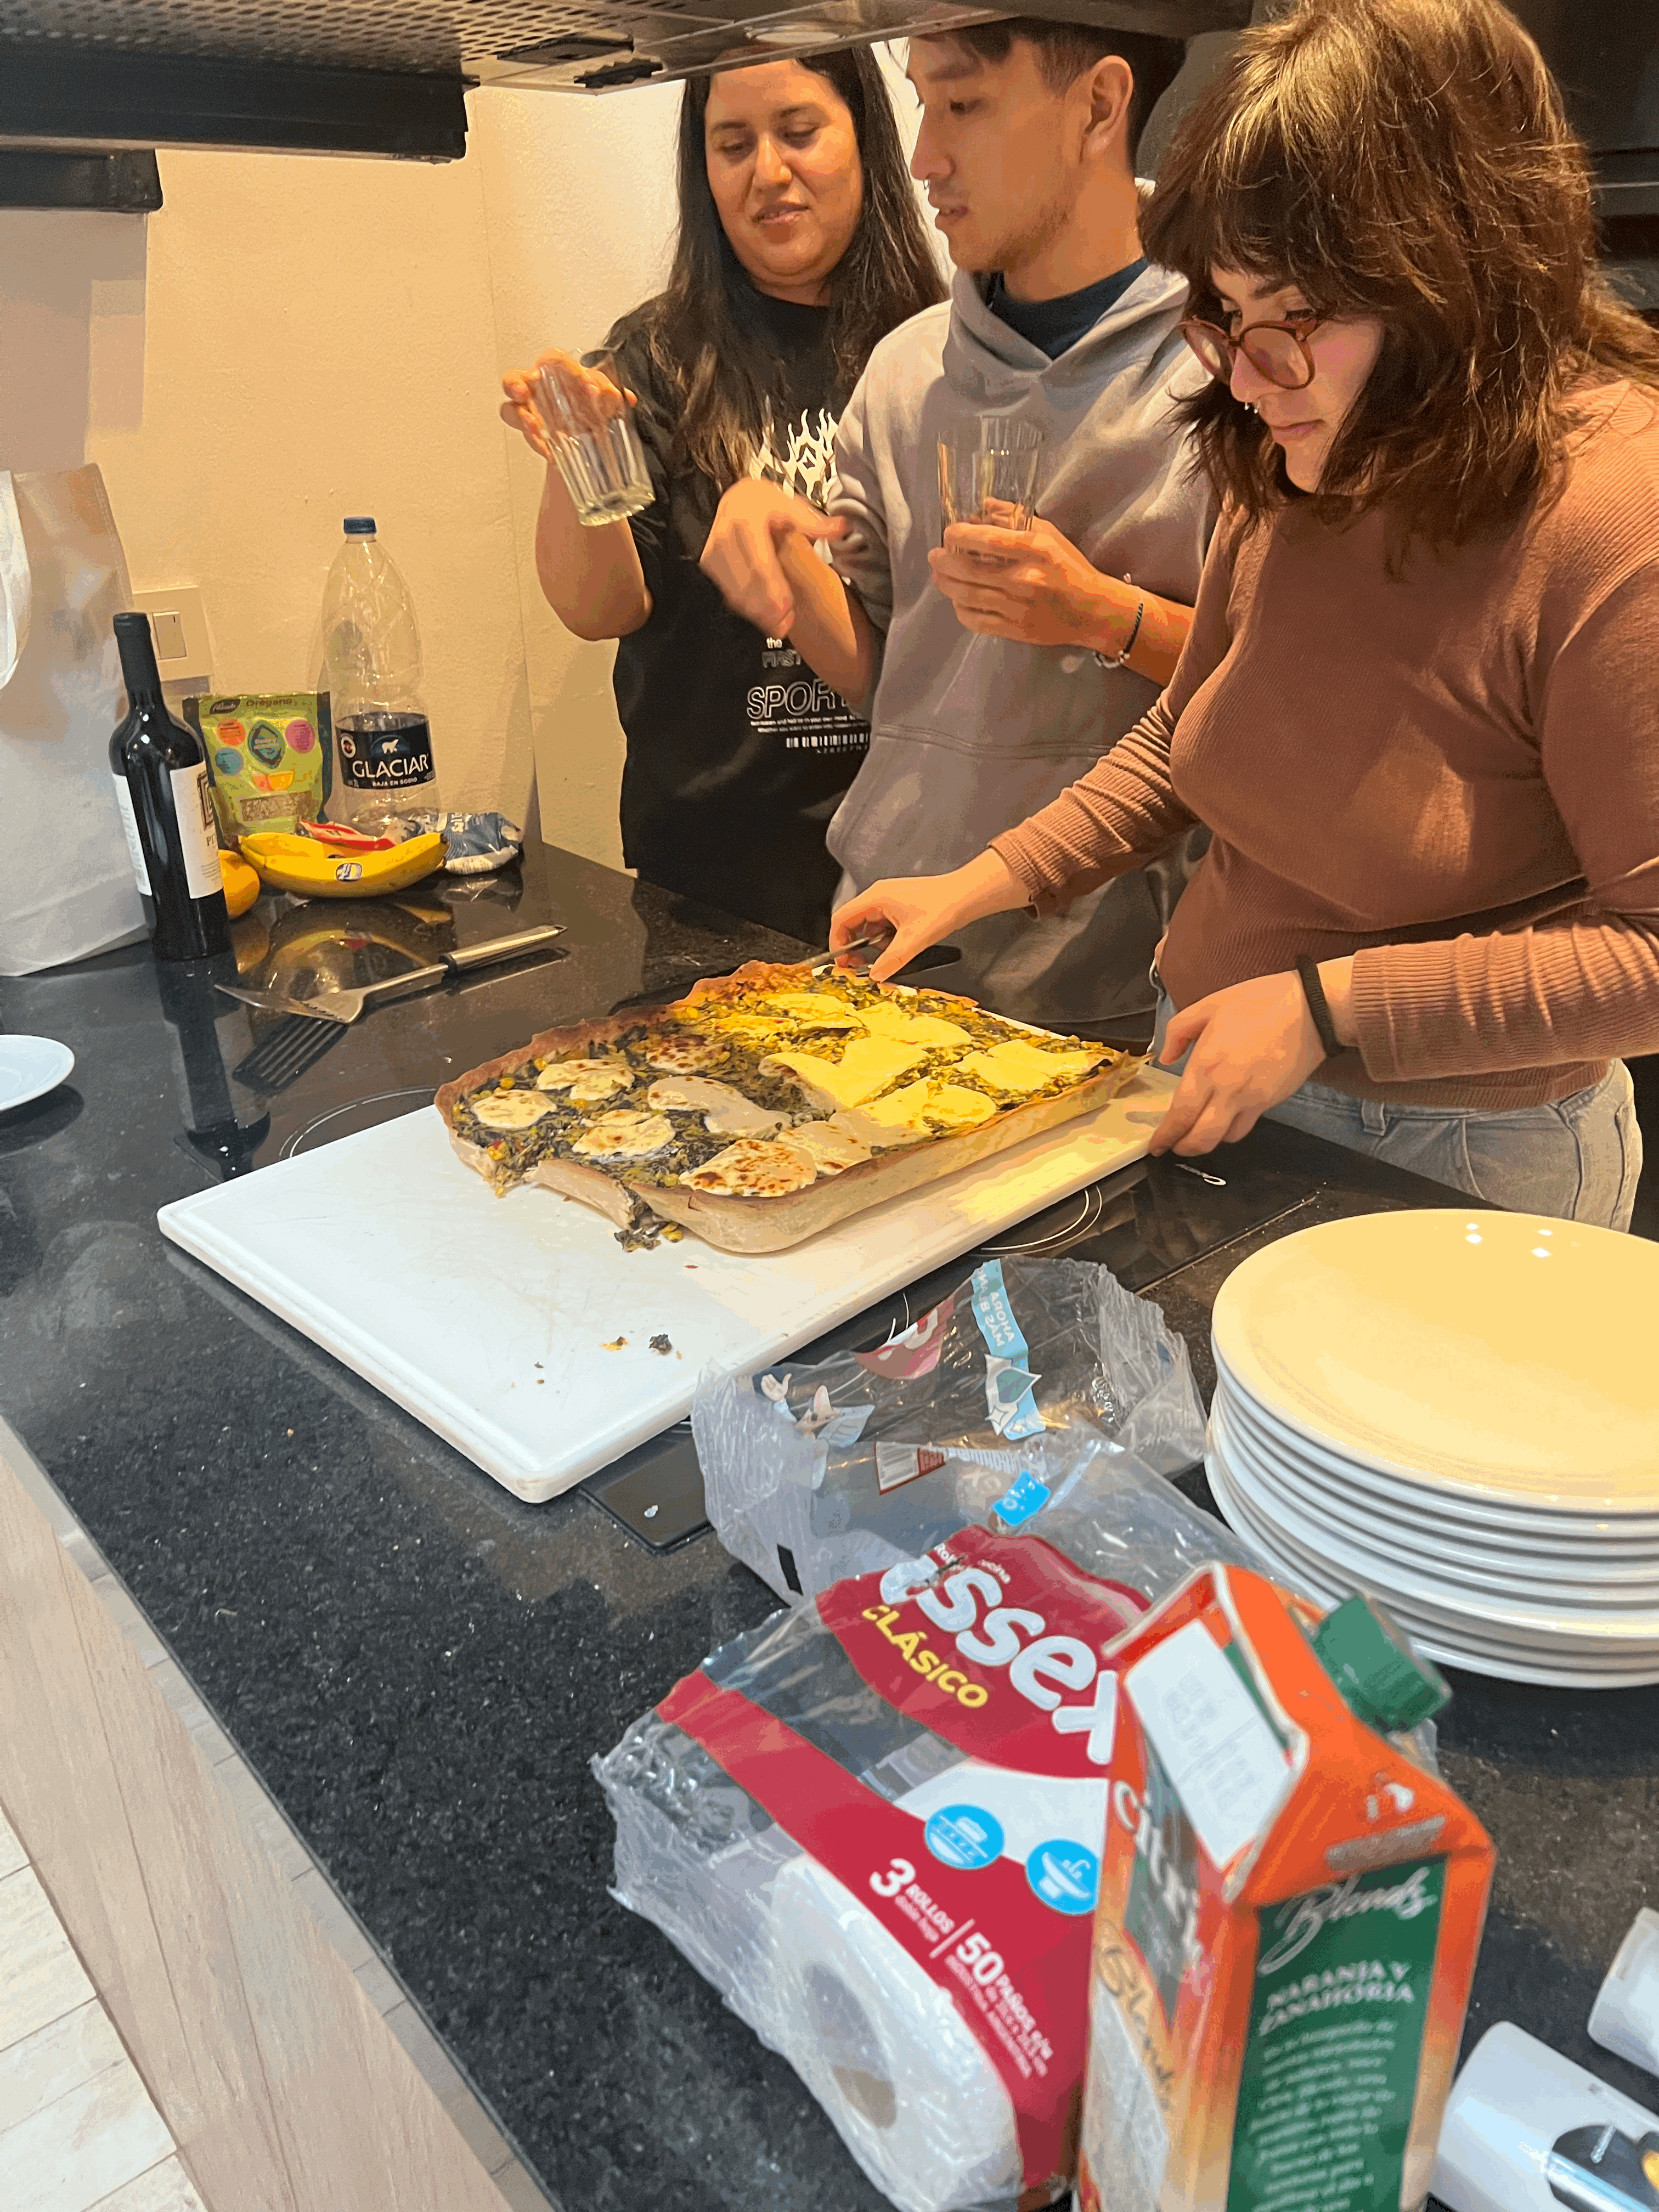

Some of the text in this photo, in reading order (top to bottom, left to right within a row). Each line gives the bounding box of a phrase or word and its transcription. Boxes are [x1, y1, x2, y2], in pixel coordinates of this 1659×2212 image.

[766, 637, 782, 648] the
[352, 754, 429, 778] GLACIAR
[400, 776, 418, 785] SODIO
[862, 1604, 988, 1708] CLÁSICO
[869, 1858, 955, 1934] 3 ROLLOS
[956, 1932, 1005, 1985] 50
